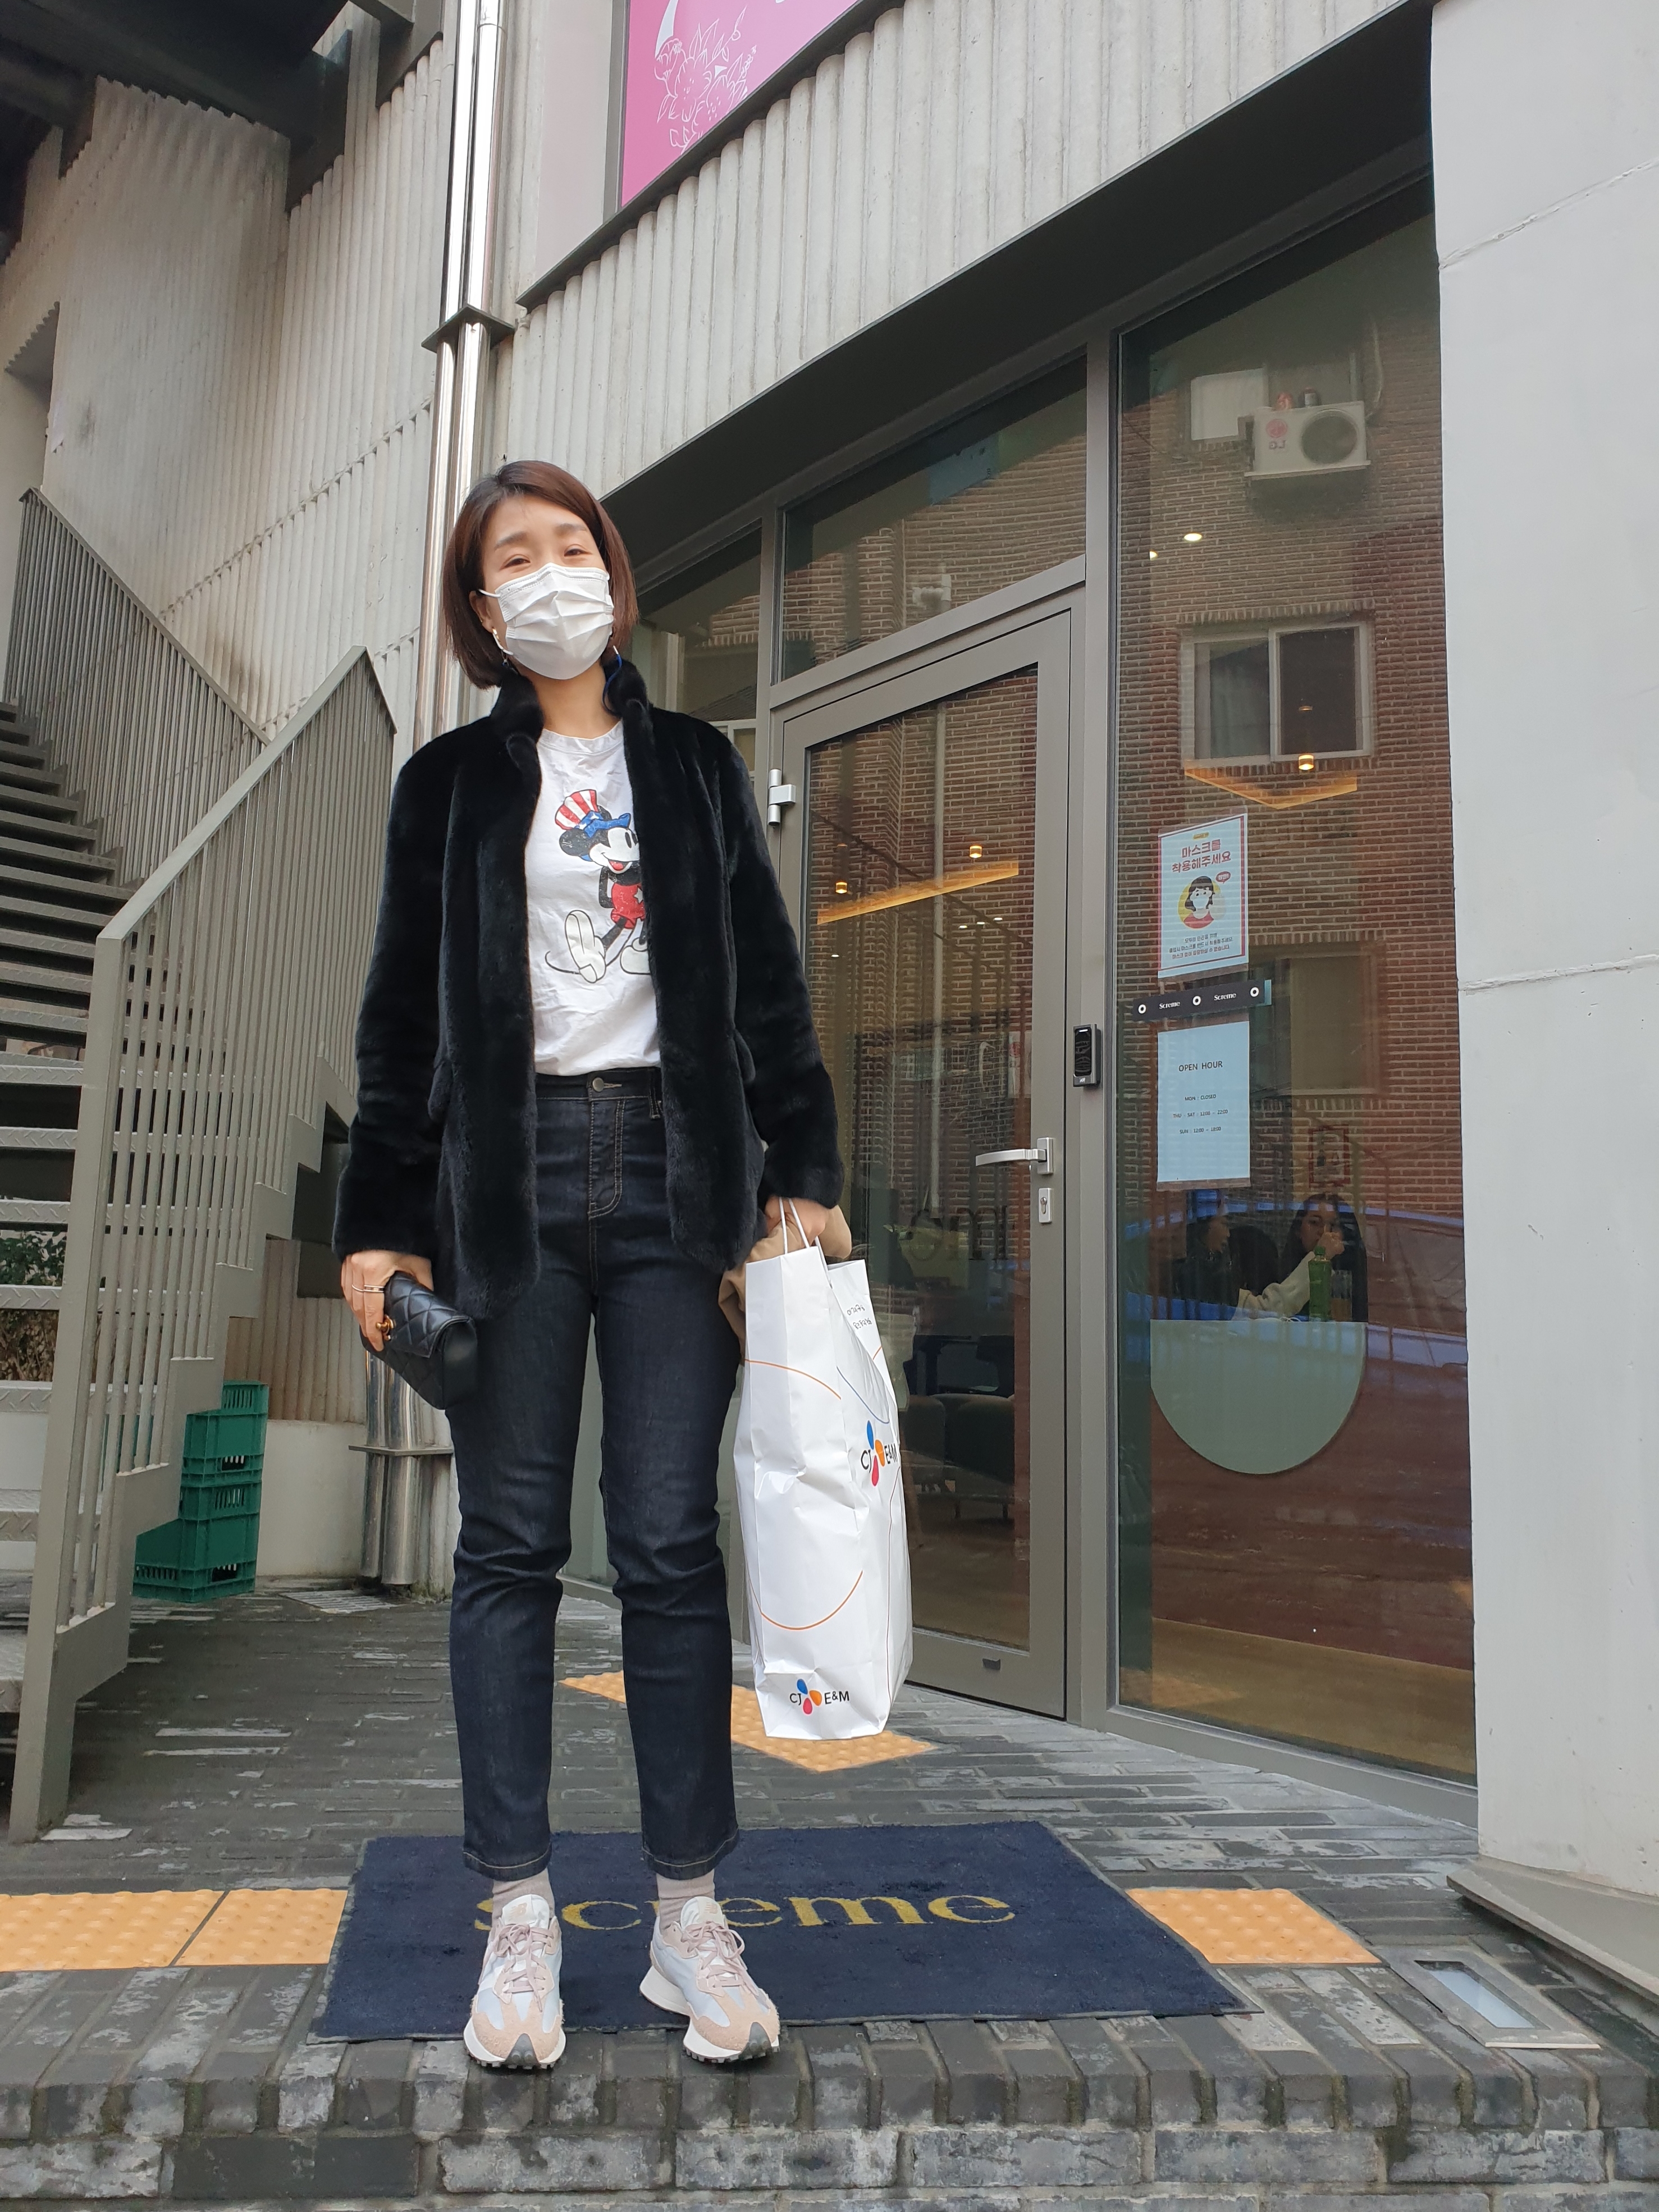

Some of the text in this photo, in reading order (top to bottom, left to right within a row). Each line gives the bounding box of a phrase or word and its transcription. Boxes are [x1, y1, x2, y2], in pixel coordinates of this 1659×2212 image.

[1182, 839, 1221, 858] 마스크를
[1172, 851, 1231, 872] 착용해주세요
[1159, 1001, 1181, 1009] Screme
[1178, 1061, 1223, 1072] OPEN HOUR
[861, 1443, 898, 1474] CJ E&M
[789, 1691, 849, 1706] CJ E&M
[474, 1895, 1015, 1930] ceme
